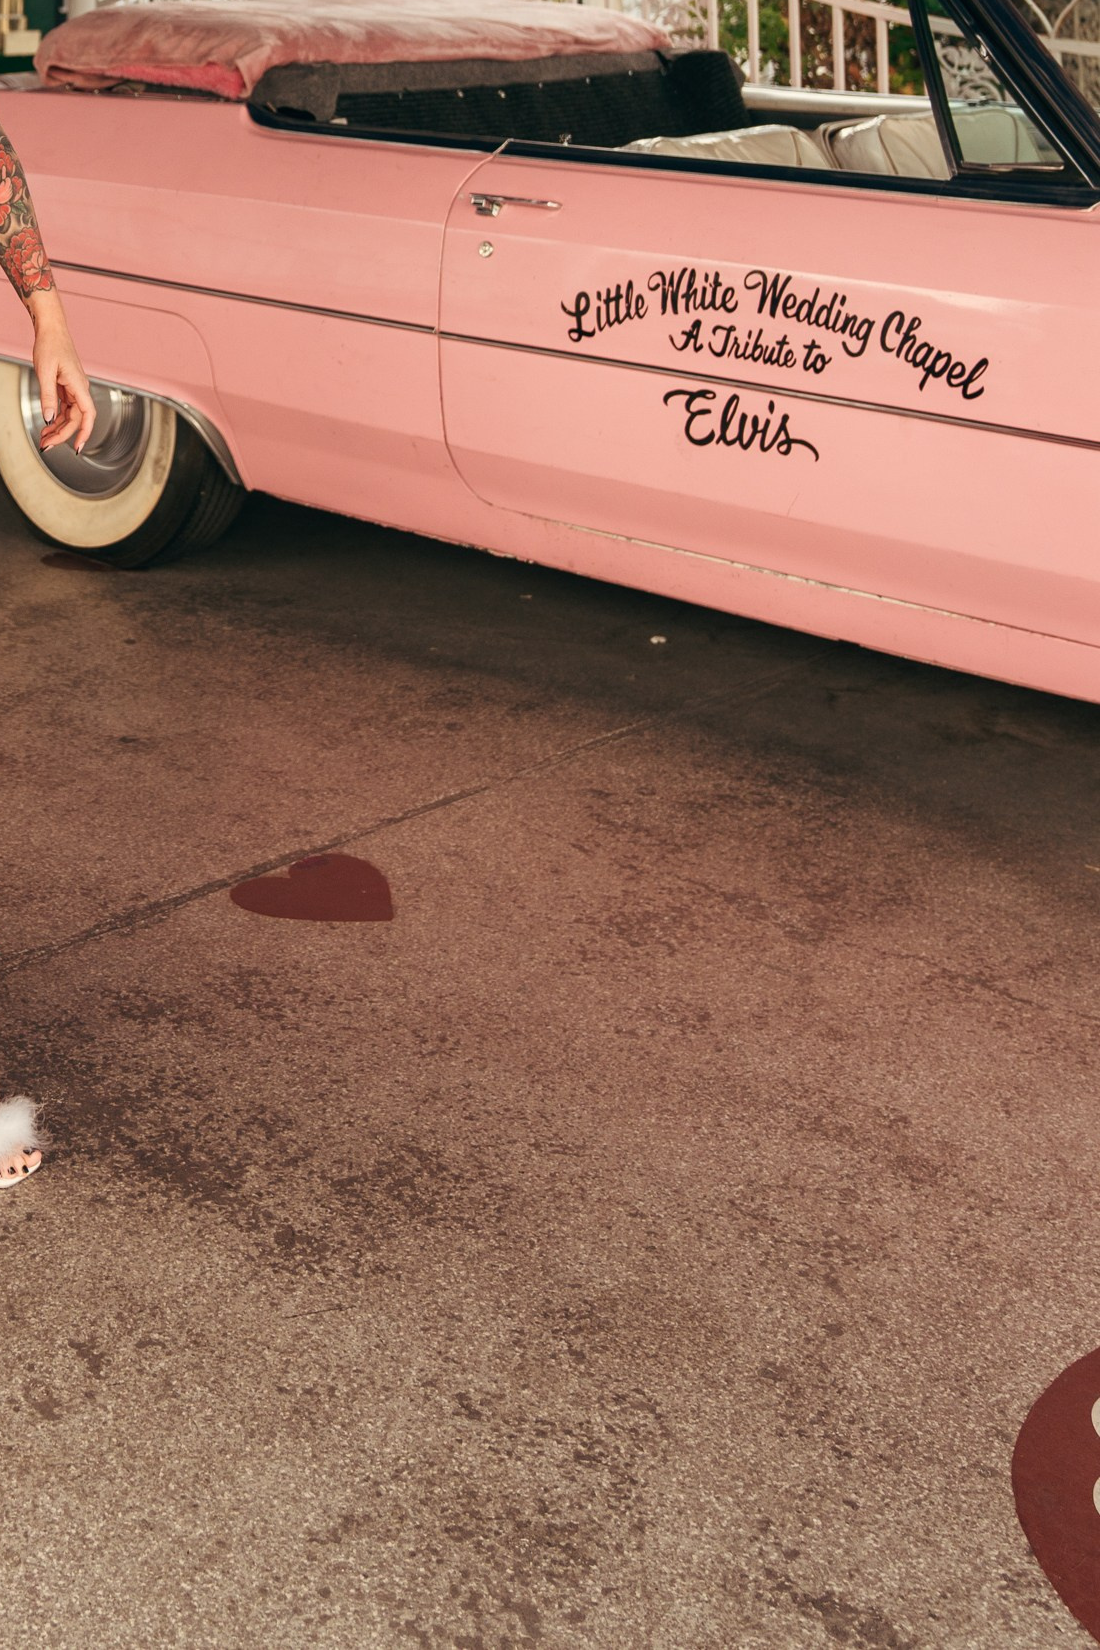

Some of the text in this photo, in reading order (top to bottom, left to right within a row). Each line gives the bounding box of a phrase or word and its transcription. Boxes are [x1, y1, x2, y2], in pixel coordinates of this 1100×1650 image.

[561, 267, 989, 400] Little White Wedding Chapel
[668, 319, 833, 374] A Tribute to
[662, 389, 820, 462] Elvis
